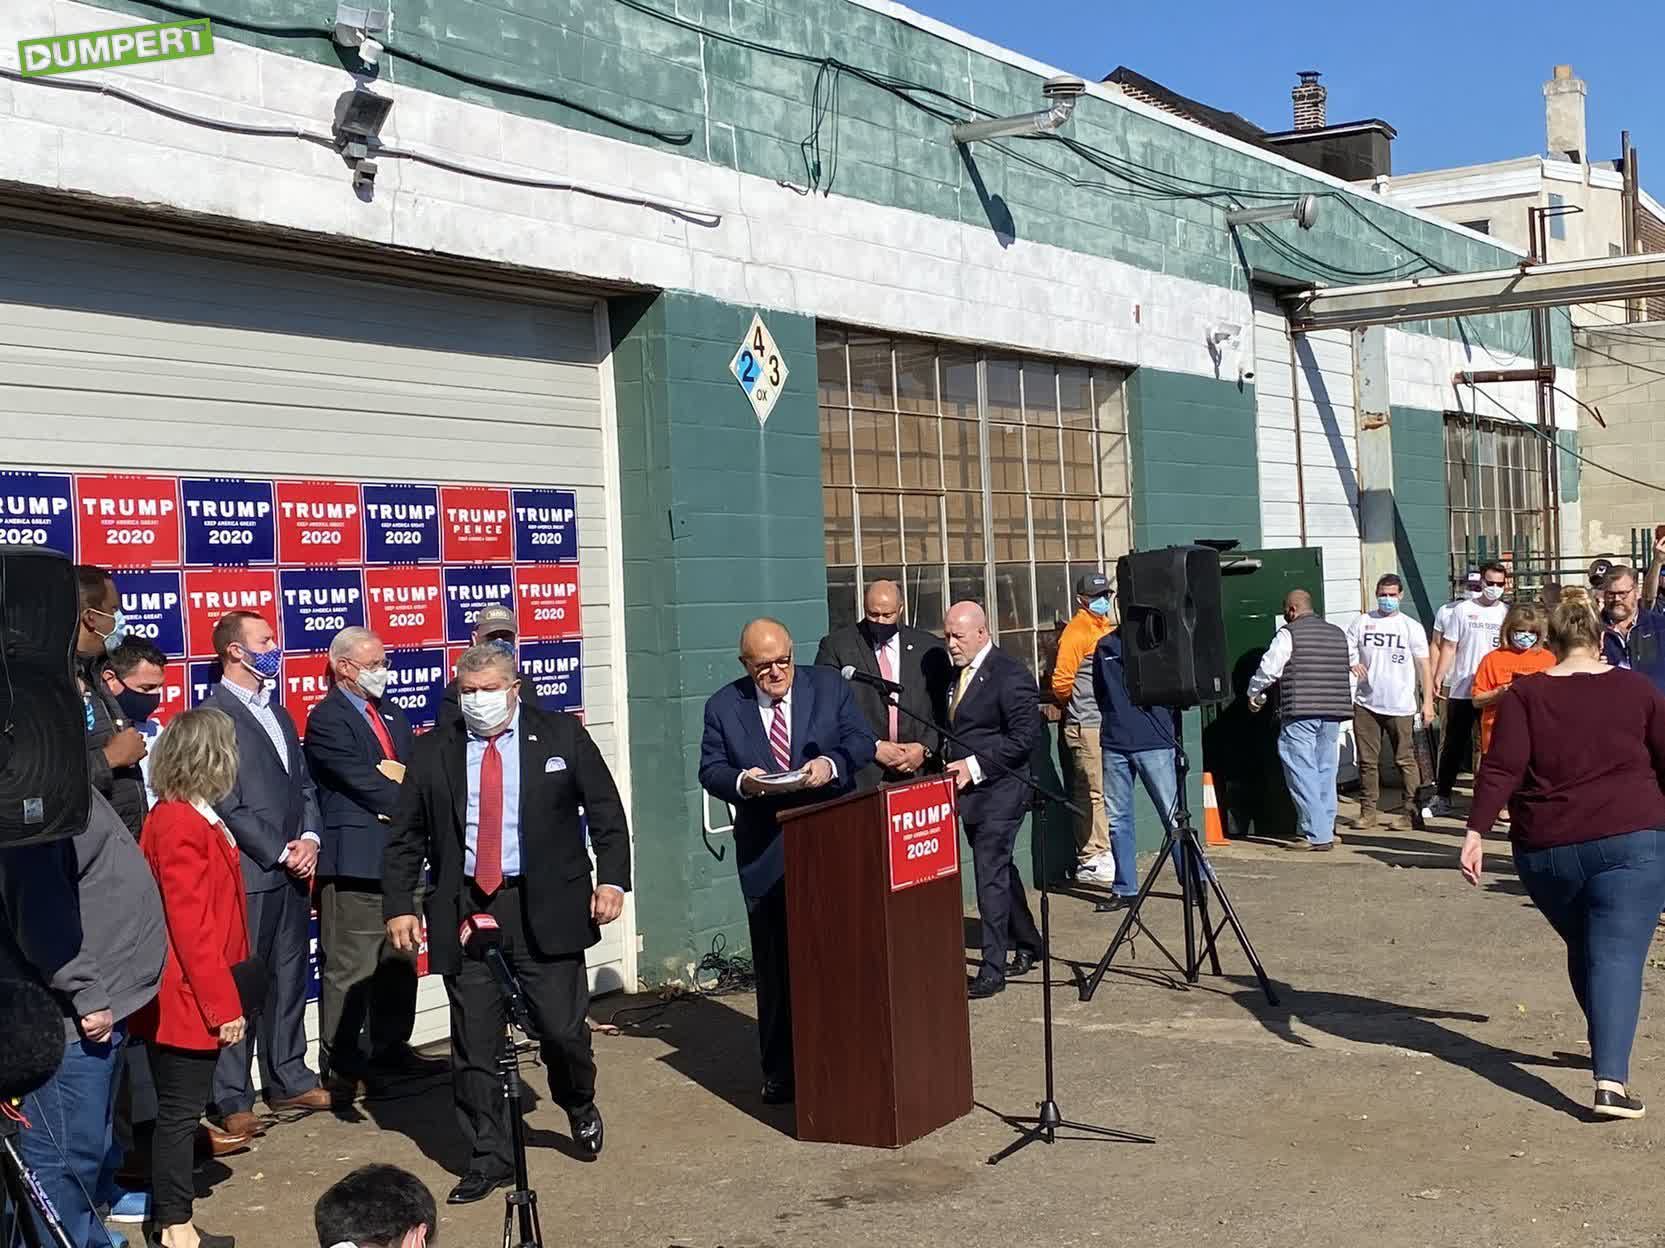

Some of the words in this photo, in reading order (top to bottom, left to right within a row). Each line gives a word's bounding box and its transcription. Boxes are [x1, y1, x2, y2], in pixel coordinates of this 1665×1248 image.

[753, 326, 765, 357] 4
[741, 350, 755, 382] 2
[769, 355, 780, 387] 3
[756, 389, 768, 401] OX
[0, 496, 68, 515] UMP
[82, 498, 174, 516] TRUMP
[187, 500, 270, 518] TRUMP
[281, 502, 357, 519] TRUMP
[367, 504, 436, 520] TRUMP
[447, 508, 507, 523] TRUMP
[516, 508, 574, 522] TRUMP
[0, 528, 48, 545] 2020
[106, 529, 155, 545] 2020
[208, 530, 253, 545] 2020
[301, 530, 341, 545] 2020
[385, 531, 421, 544] 2020
[453, 525, 502, 534] PENCE
[531, 533, 562, 545] 2020
[284, 588, 360, 605] TRUMP
[369, 586, 438, 603] TRUMP
[447, 584, 511, 600] TRUMP
[519, 583, 576, 598] TRUMP
[121, 592, 177, 611] UMP
[190, 590, 272, 608] TRUMP
[389, 613, 425, 627] 2020
[464, 610, 481, 623] 20
[534, 607, 565, 620] 2020
[125, 623, 159, 639] 020
[304, 616, 345, 631] 2020
[1363, 632, 1406, 649] FSTL
[521, 657, 579, 674] TRUMP
[1391, 653, 1405, 664] 92
[288, 675, 328, 693] TRU
[387, 667, 442, 685] RUMP
[535, 682, 567, 696] 2020
[892, 803, 951, 833] TRUMP
[907, 838, 939, 860] 2020
